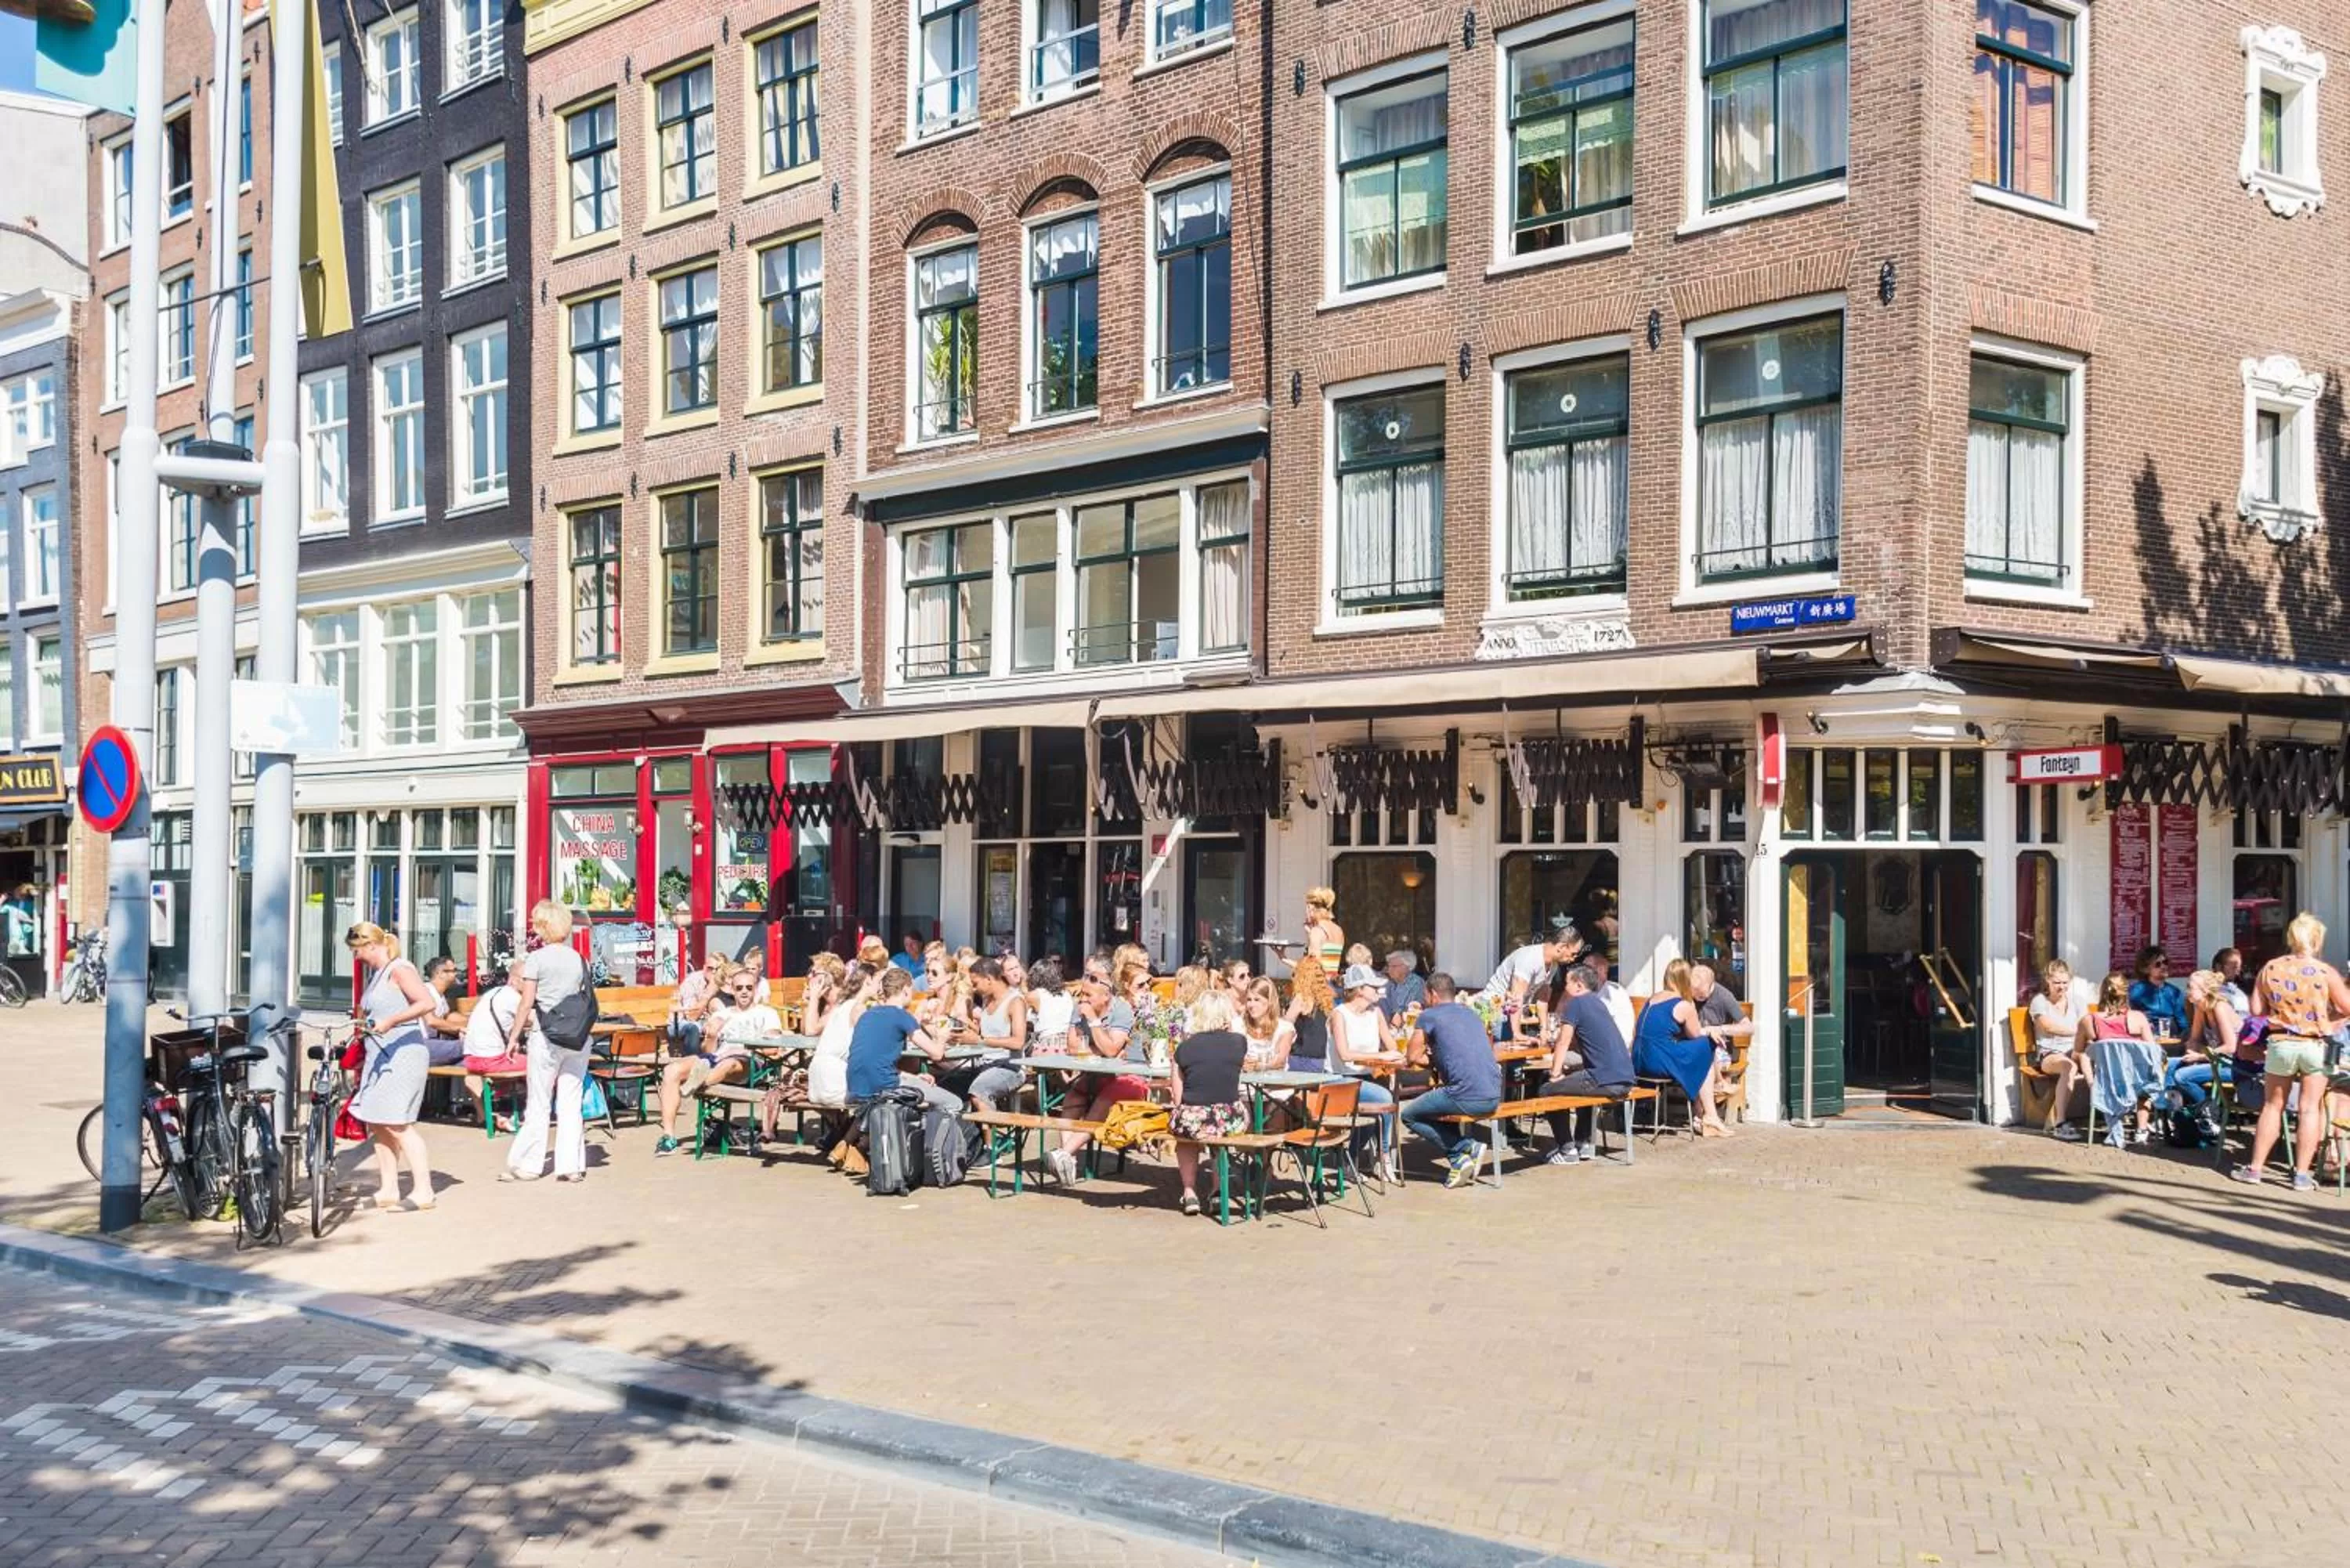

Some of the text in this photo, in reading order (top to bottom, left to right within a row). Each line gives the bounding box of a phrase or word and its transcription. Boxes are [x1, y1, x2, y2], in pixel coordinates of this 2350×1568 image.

[1736, 602, 1795, 620] NIEUWMARKT
[2041, 755, 2081, 775] Fonteyn
[16, 768, 52, 789] CLUB
[573, 814, 615, 833] CHINA
[560, 840, 627, 860] MASSAGE
[739, 836, 765, 848] OPEN
